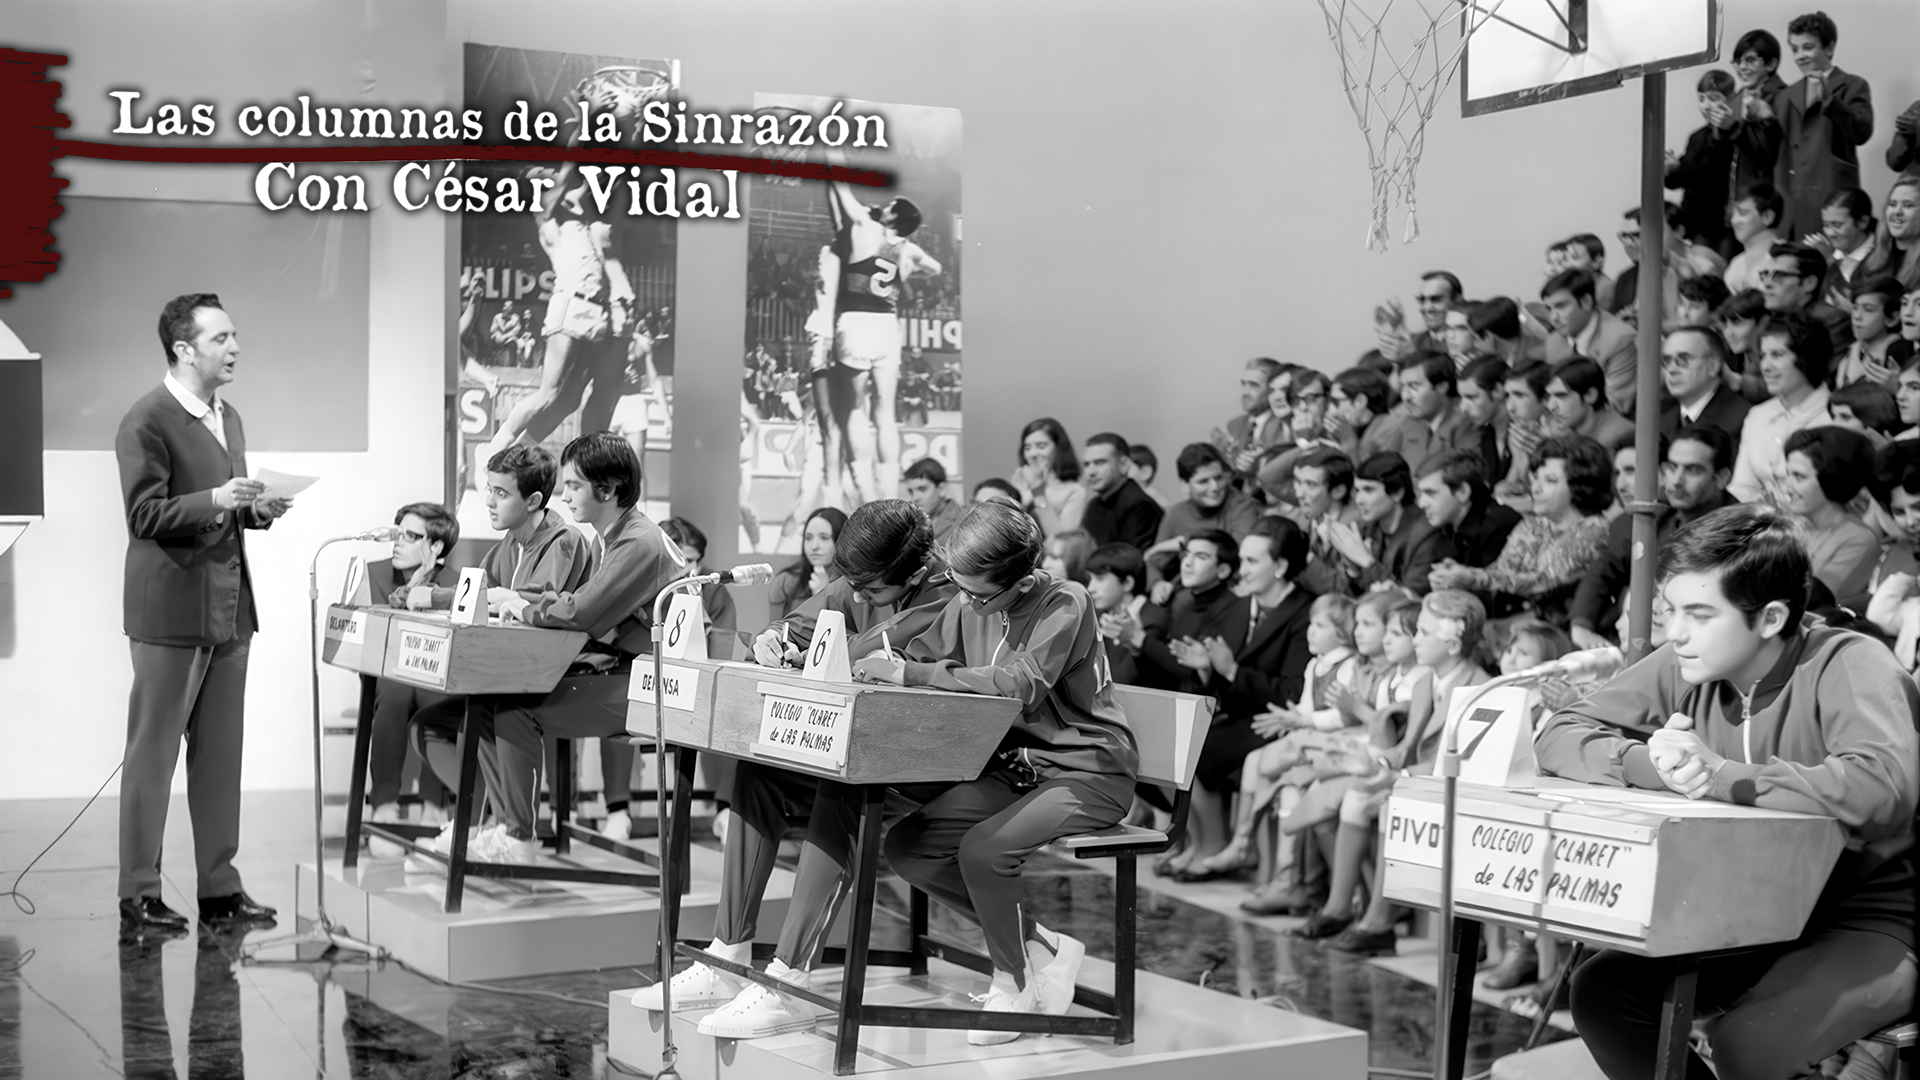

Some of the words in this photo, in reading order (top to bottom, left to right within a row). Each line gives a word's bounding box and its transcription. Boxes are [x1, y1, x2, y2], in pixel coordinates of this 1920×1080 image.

[457, 577, 471, 612] 2
[668, 608, 687, 648] 8
[812, 627, 832, 668] 6
[770, 700, 802, 723] COLEGIO
[807, 705, 844, 729] "CLARET"
[1459, 707, 1505, 761] 7
[769, 726, 779, 742] de
[781, 728, 798, 746] LAS
[800, 731, 834, 753] PALMAS
[1389, 815, 1445, 848] PIVO
[1471, 824, 1534, 855] COLEGIO
[1551, 834, 1632, 869] "CLARET"
[1474, 862, 1495, 886] de
[1502, 865, 1539, 893] LAS
[1545, 871, 1623, 908] PALMAS
